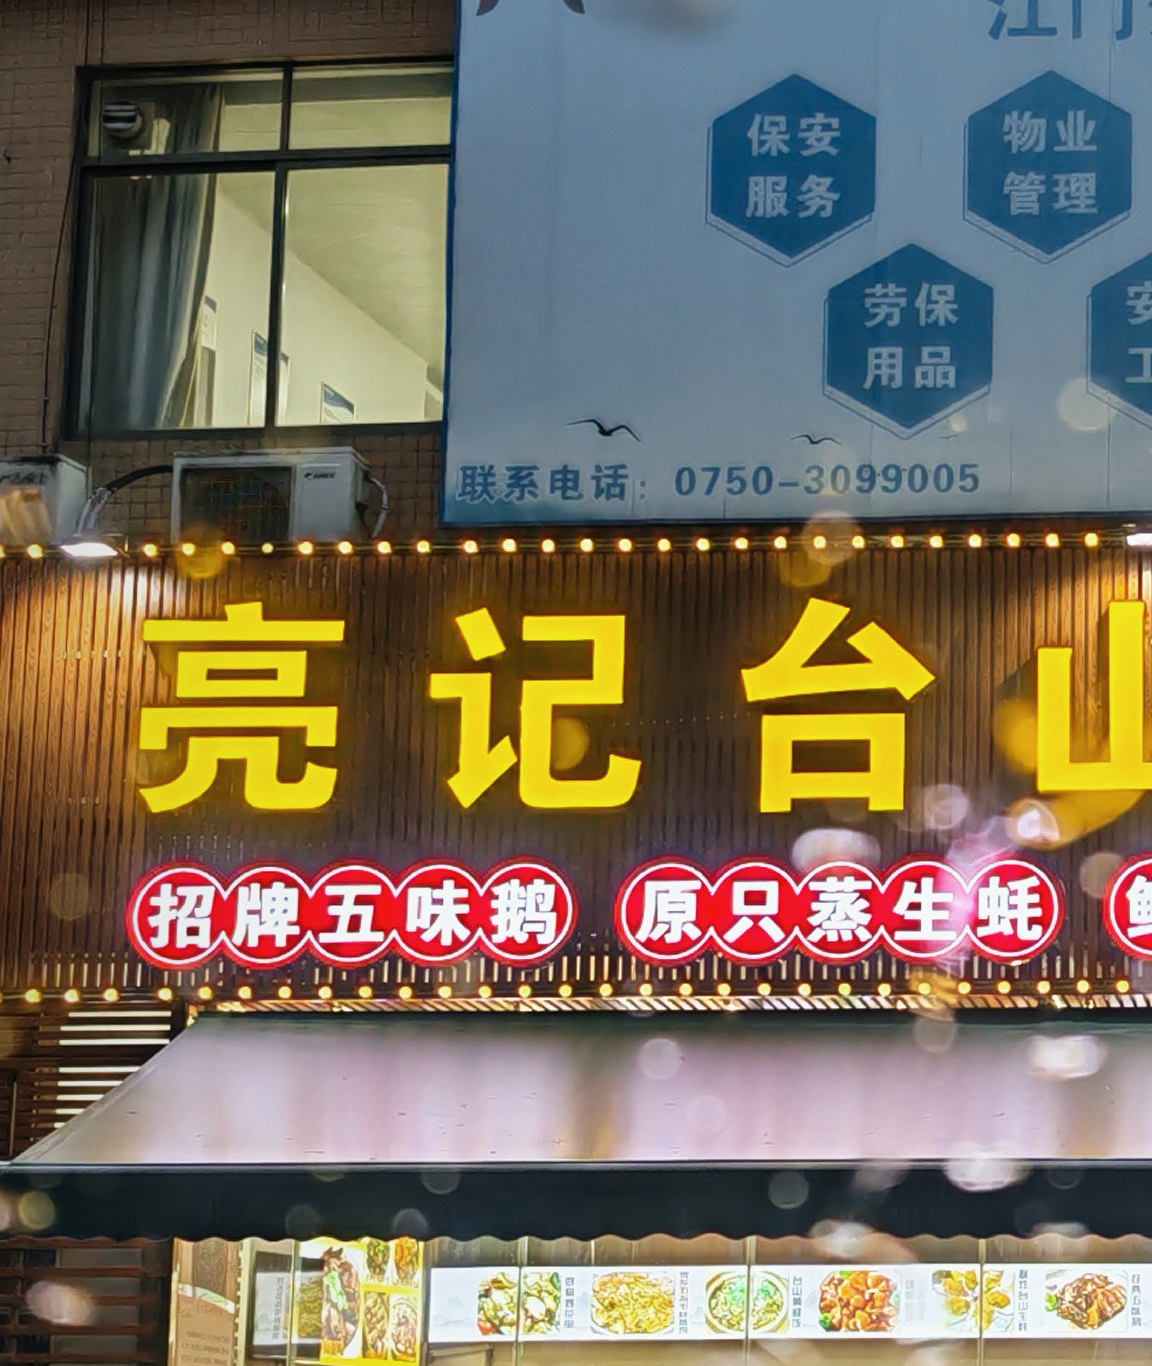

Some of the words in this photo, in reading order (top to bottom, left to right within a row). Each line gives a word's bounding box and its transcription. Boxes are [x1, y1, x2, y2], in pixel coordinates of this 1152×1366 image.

[746, 113, 841, 156] 保安
[1002, 110, 1098, 154] 物业
[746, 174, 841, 219] 服务
[1003, 171, 1099, 216] 管理
[863, 283, 959, 327] 劳保
[862, 346, 957, 390] 用品
[674, 463, 980, 496] 0750-3099005
[148, 878, 558, 949] 招牌五味鹅
[635, 875, 1044, 944] 原只蒸生蚝
